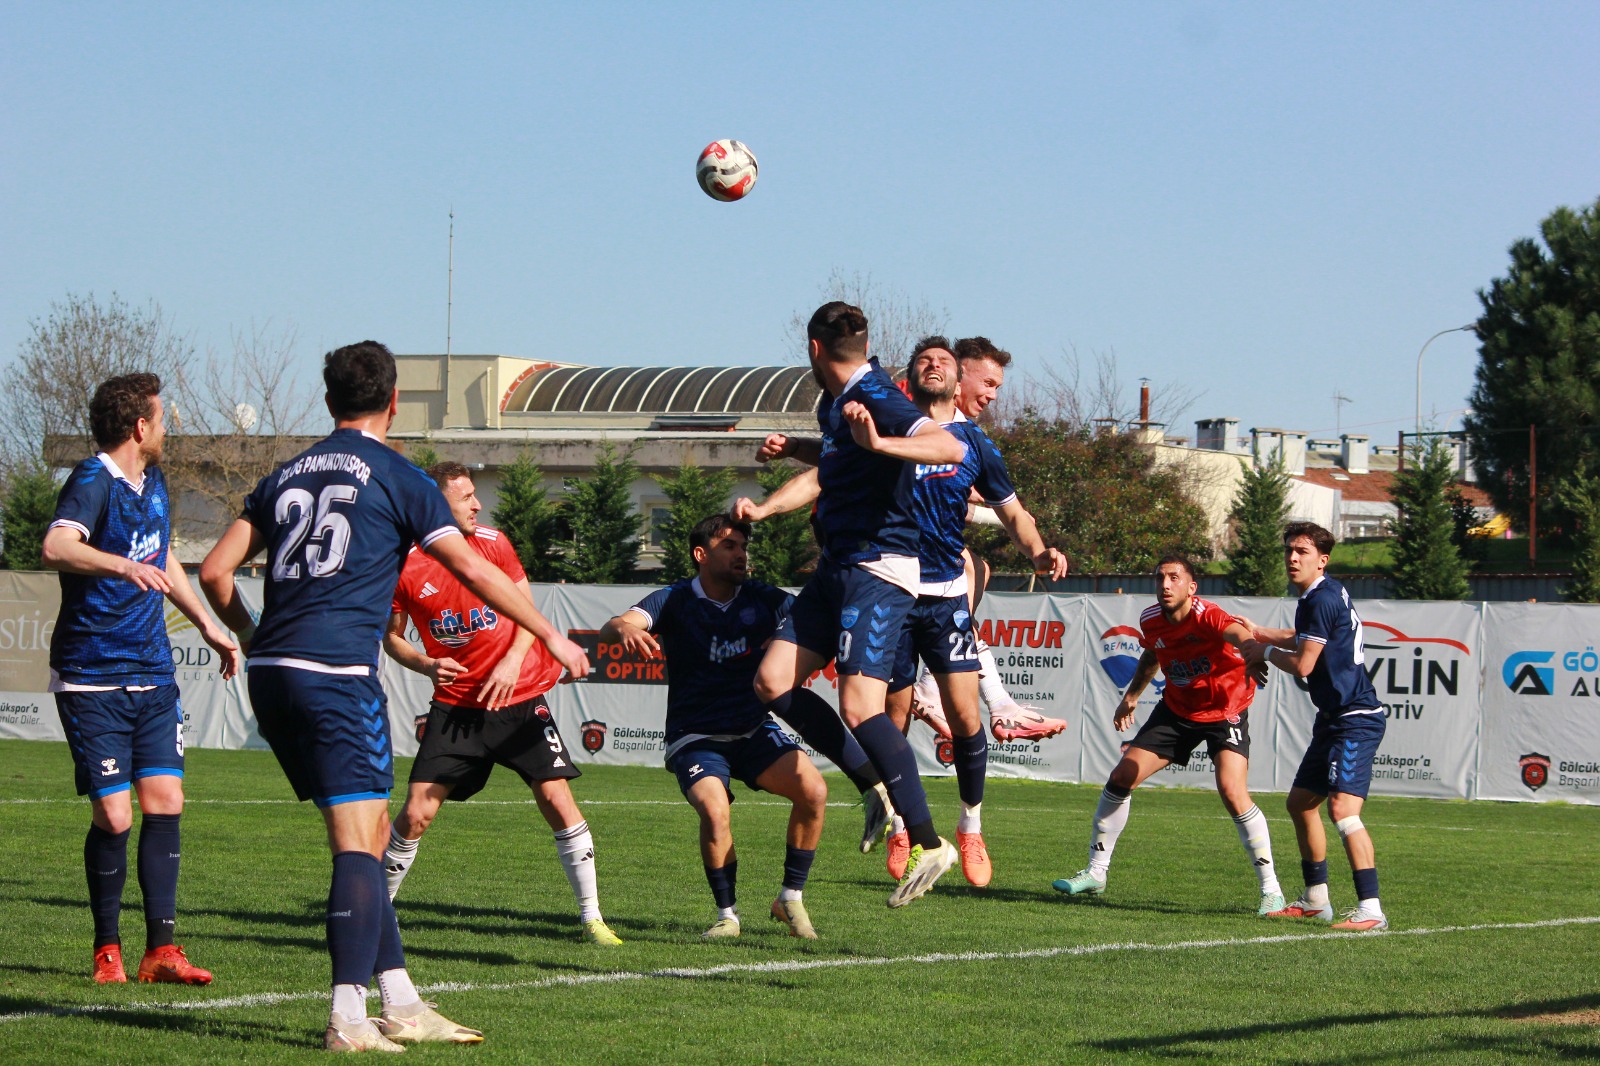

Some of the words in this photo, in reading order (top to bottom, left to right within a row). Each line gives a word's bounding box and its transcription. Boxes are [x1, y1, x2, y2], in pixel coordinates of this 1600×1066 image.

[272, 485, 358, 582] 25
[429, 605, 498, 637] GÖLAŞ
[838, 631, 852, 663] 9
[949, 631, 978, 661] 22
[1103, 642, 1142, 653] RE/MAX
[1008, 652, 1063, 668] ÖĞRENCİ
[1036, 691, 1054, 700] SAN
[544, 726, 562, 753] 9
[613, 740, 656, 752] Başarılar
